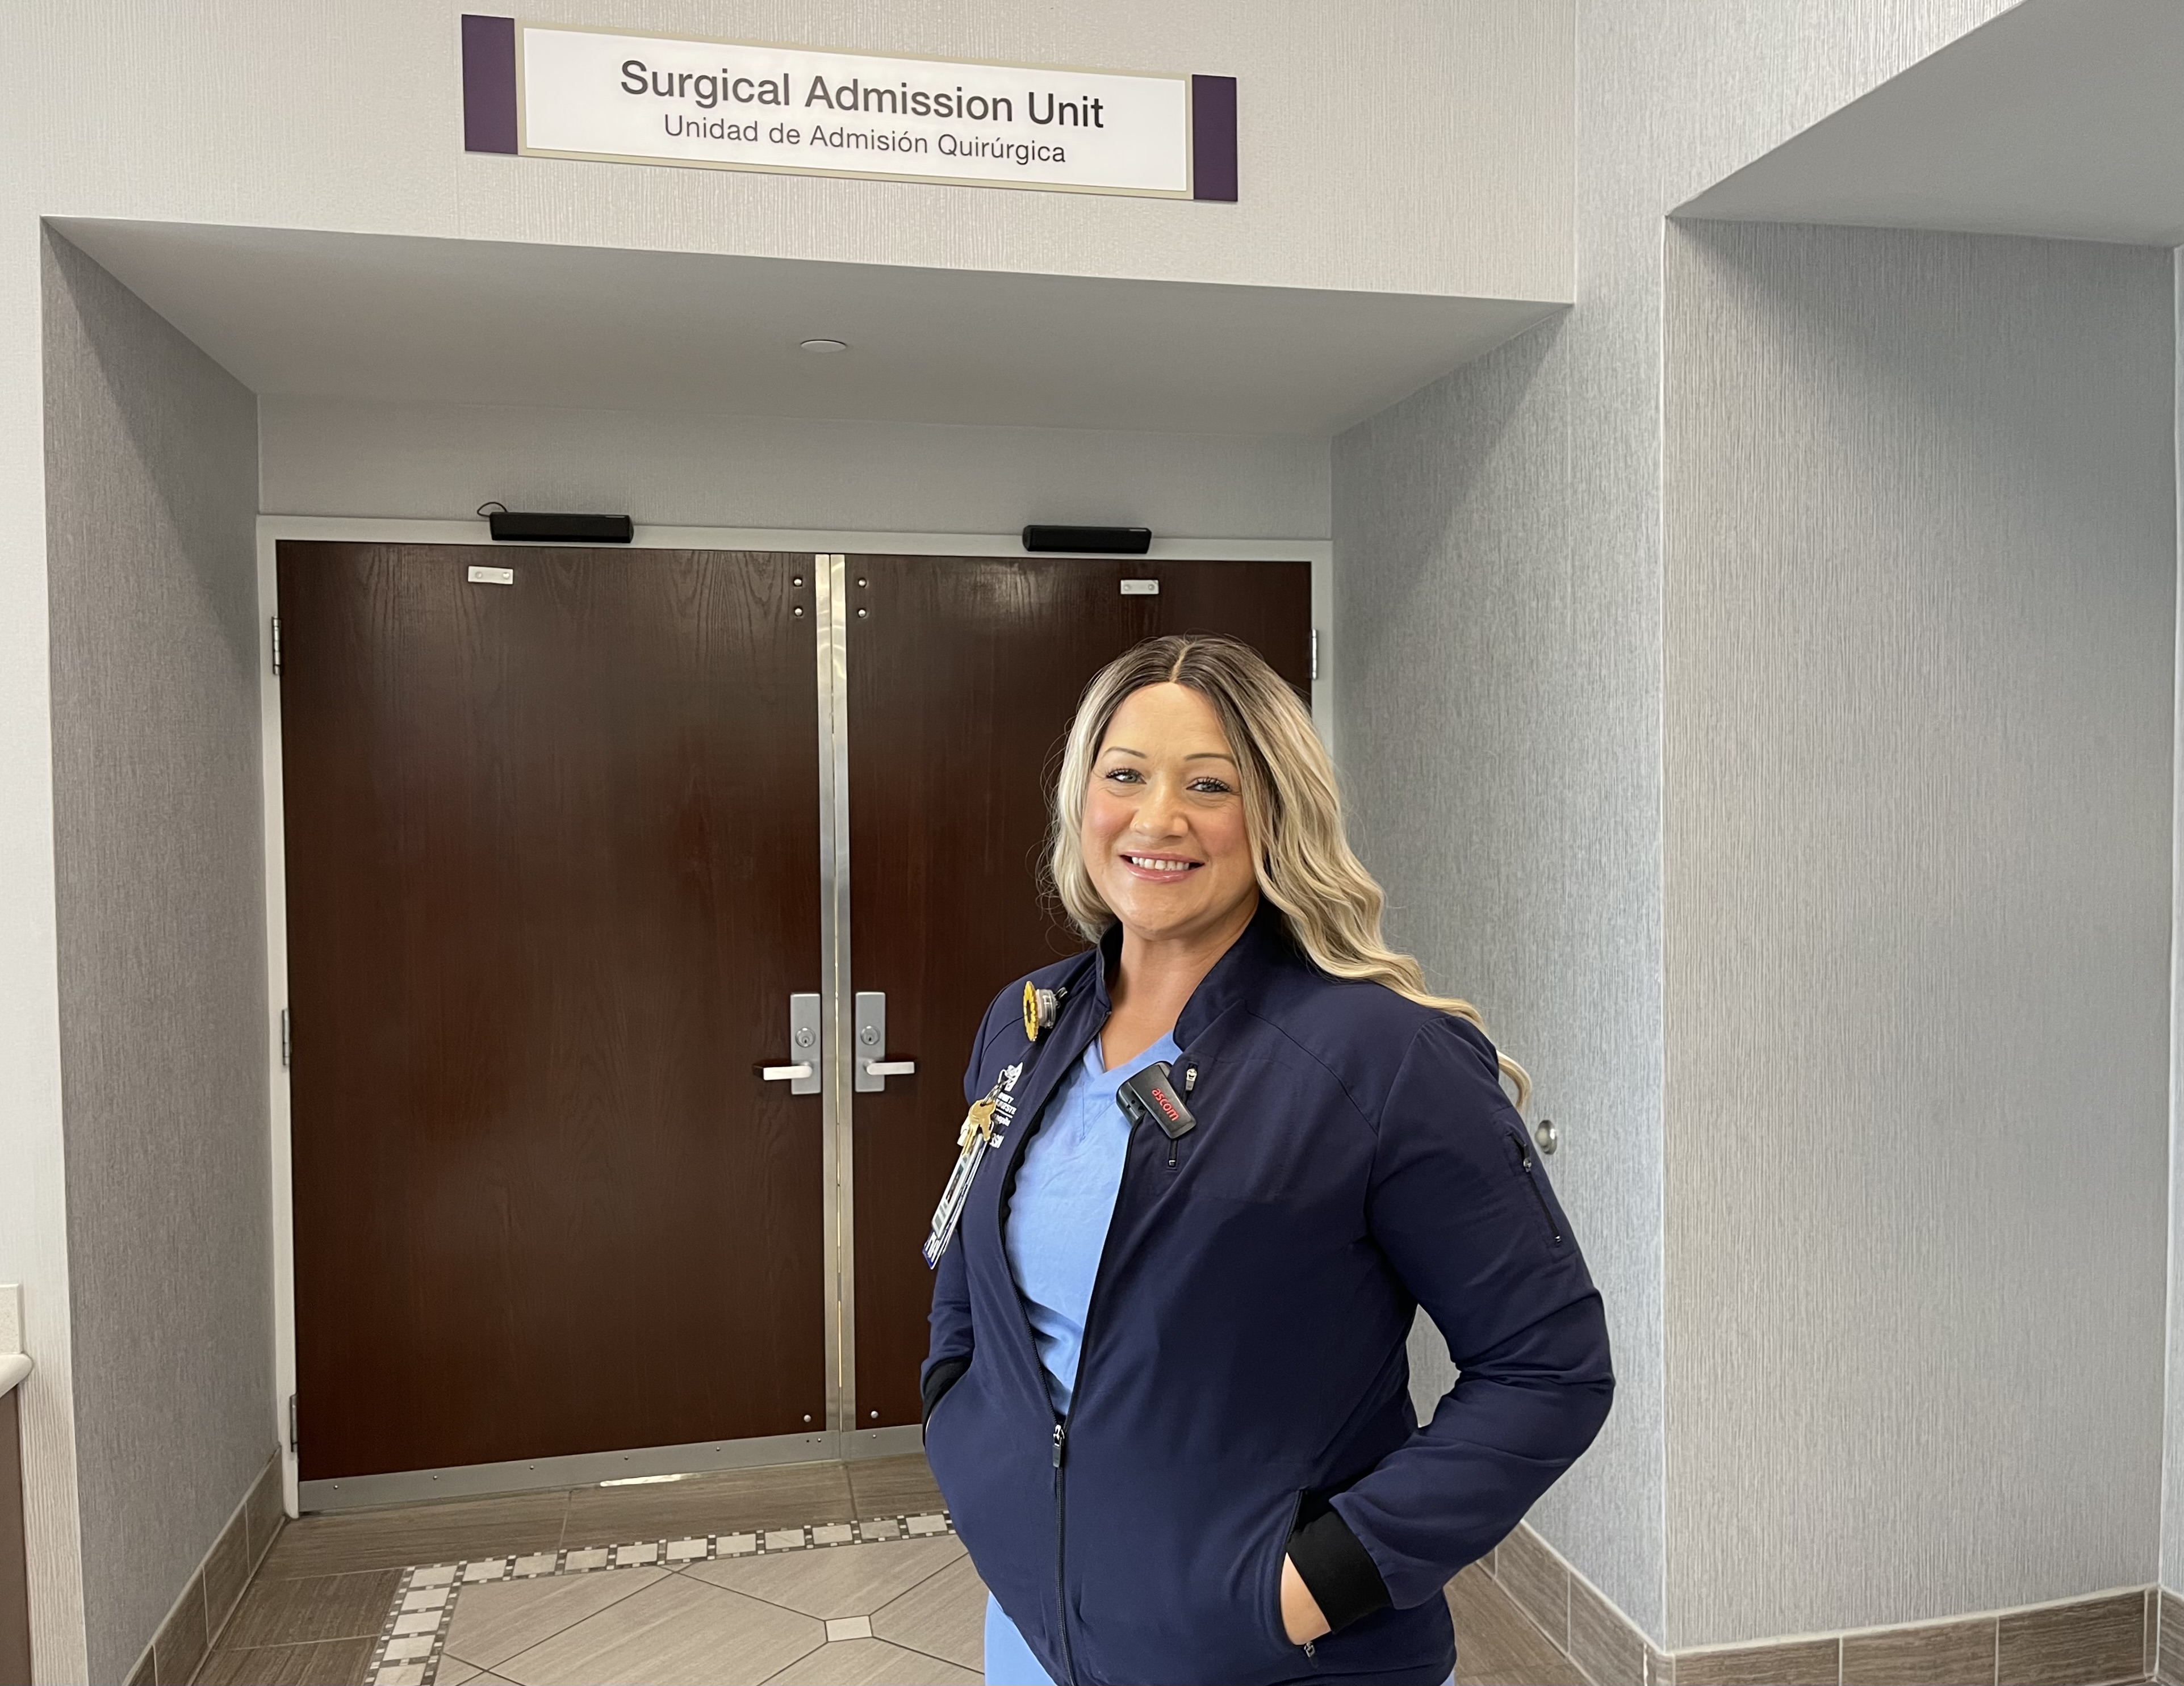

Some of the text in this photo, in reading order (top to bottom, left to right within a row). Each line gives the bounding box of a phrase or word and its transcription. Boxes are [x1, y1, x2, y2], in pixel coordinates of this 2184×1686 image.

[621, 60, 1104, 128] Surgical Admission Unit
[665, 114, 1066, 165] Unidad de Admisión Quirúrgica
[1152, 1088, 1179, 1122] ascom
